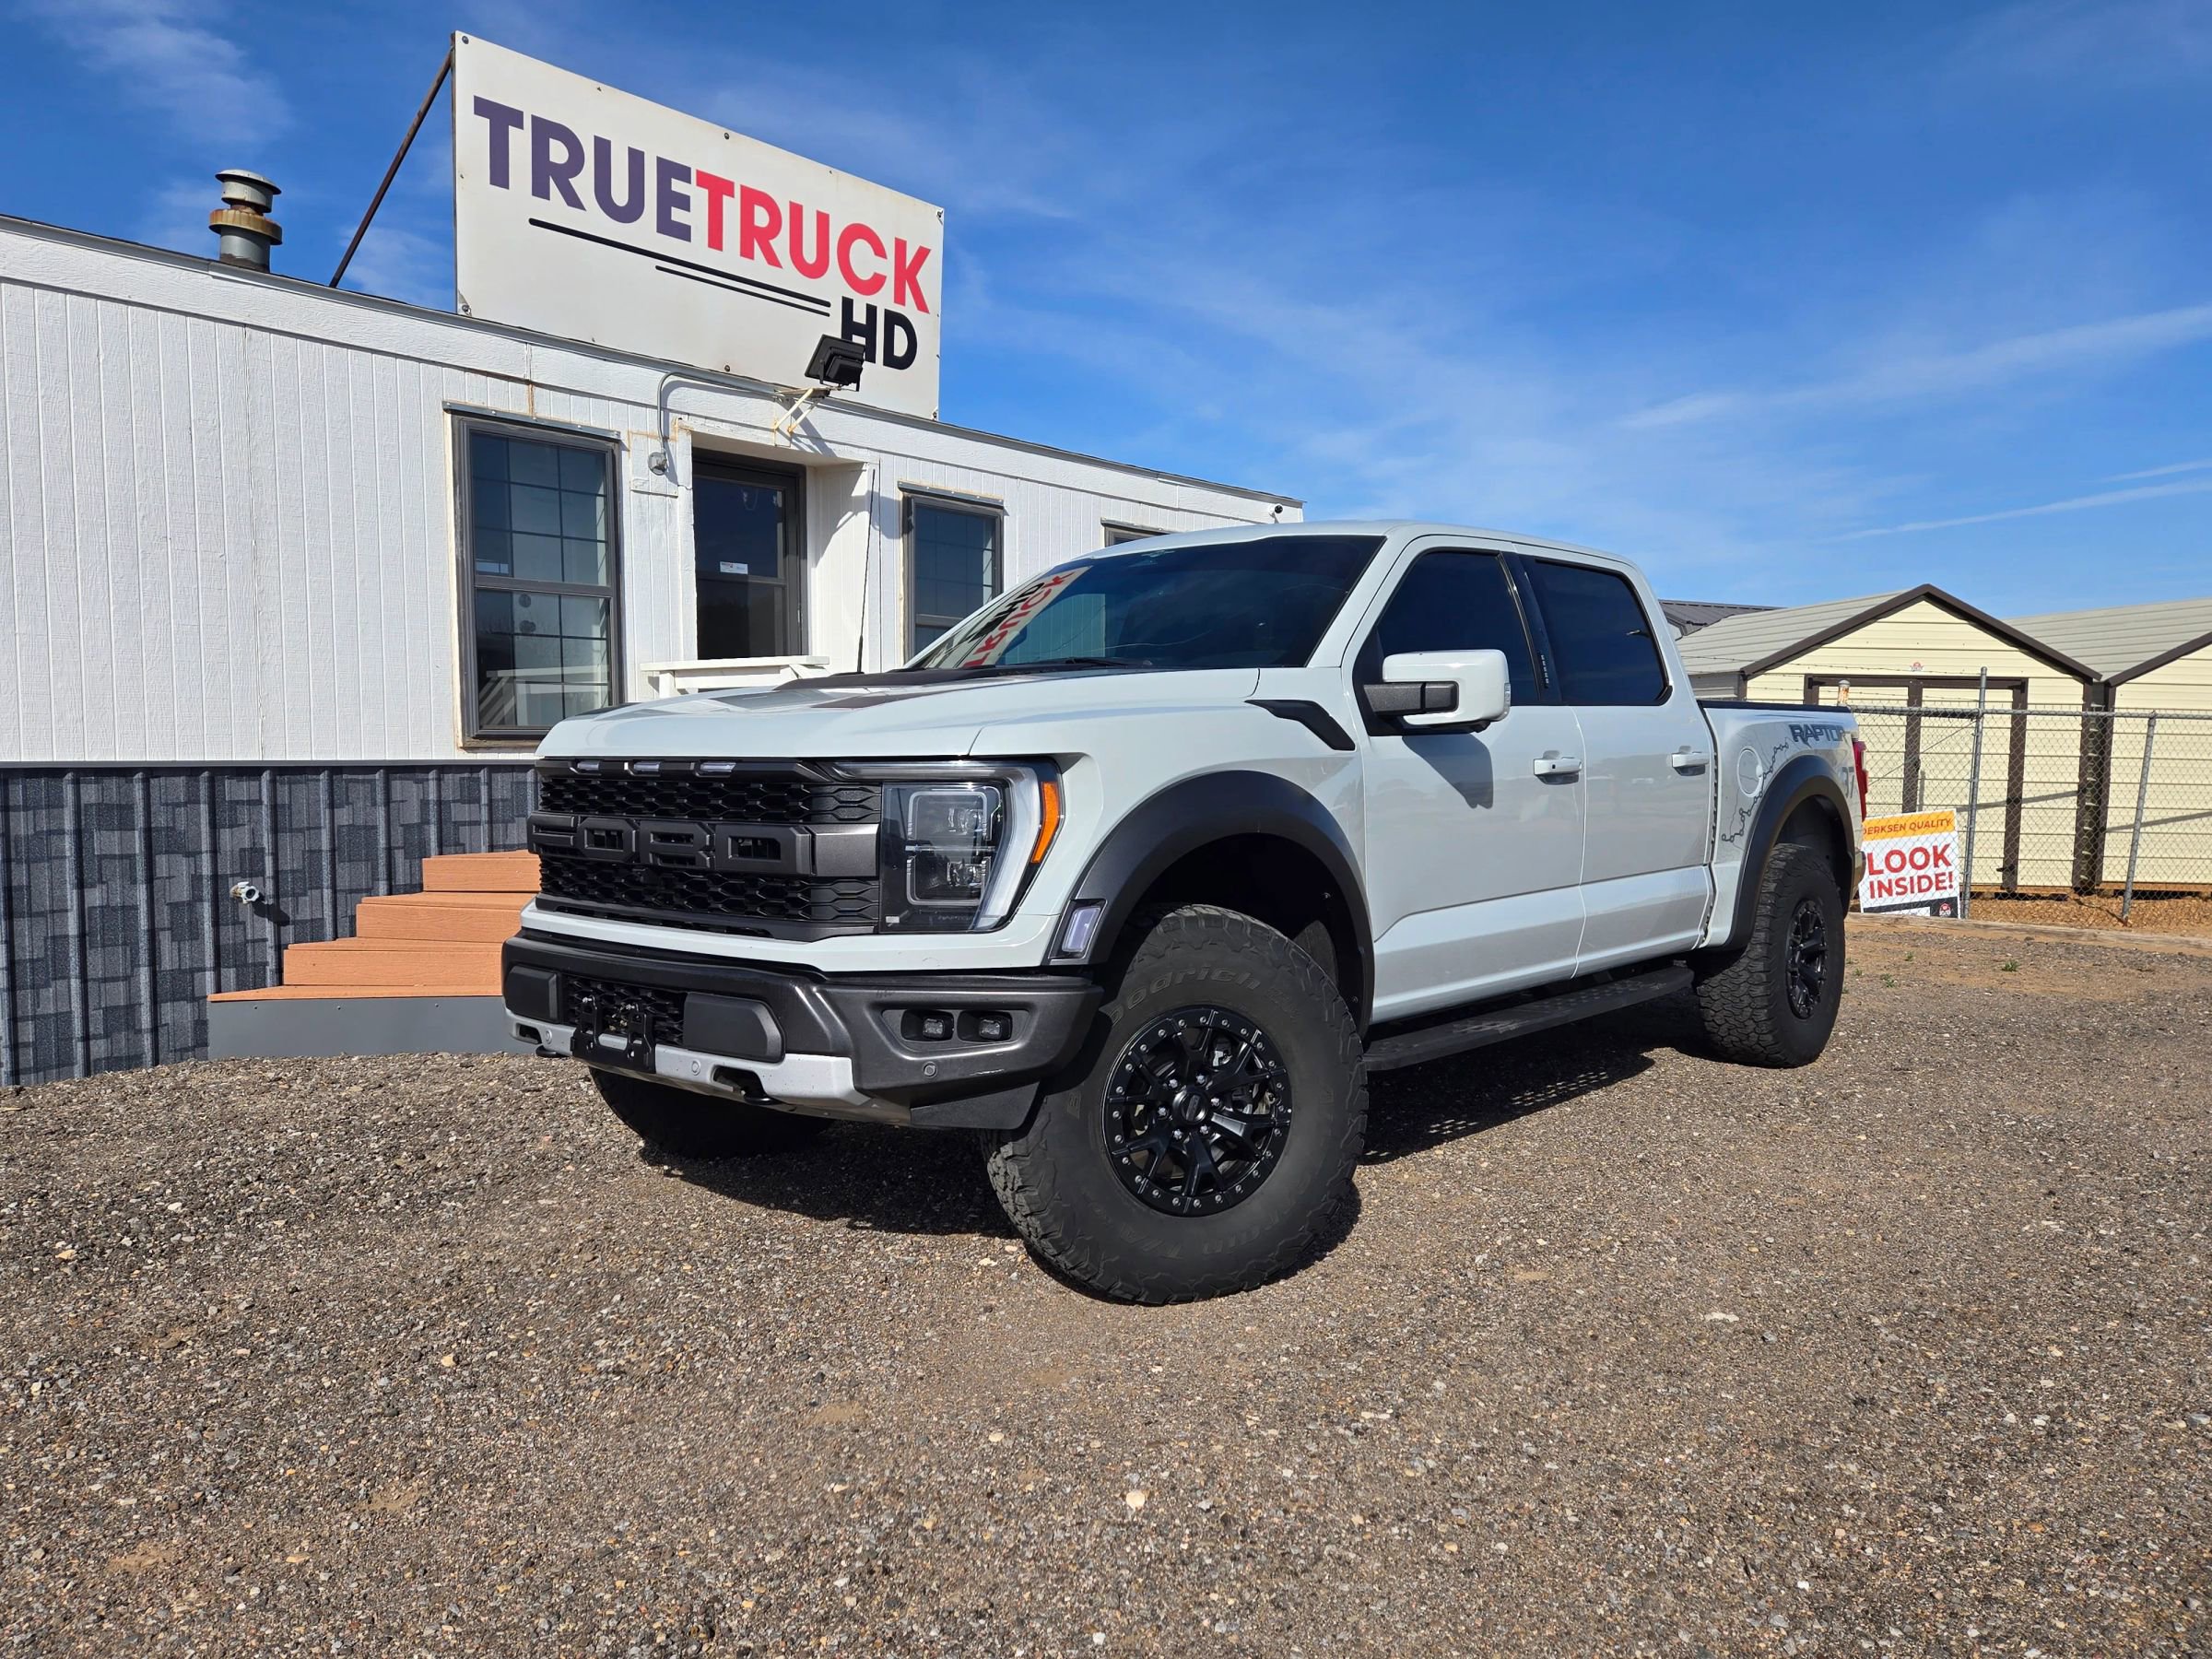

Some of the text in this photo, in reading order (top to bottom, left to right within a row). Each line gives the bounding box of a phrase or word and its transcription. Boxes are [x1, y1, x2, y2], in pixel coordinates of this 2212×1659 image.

[841, 295, 919, 371] HD
[1788, 724, 1850, 748] RAPTOR
[1909, 818, 1952, 832] QUALITY
[526, 811, 812, 876] FORD
[1866, 843, 1952, 876] LOOK
[1868, 871, 1954, 900] INSIDE!
[1107, 964, 1262, 1027] oodrich
